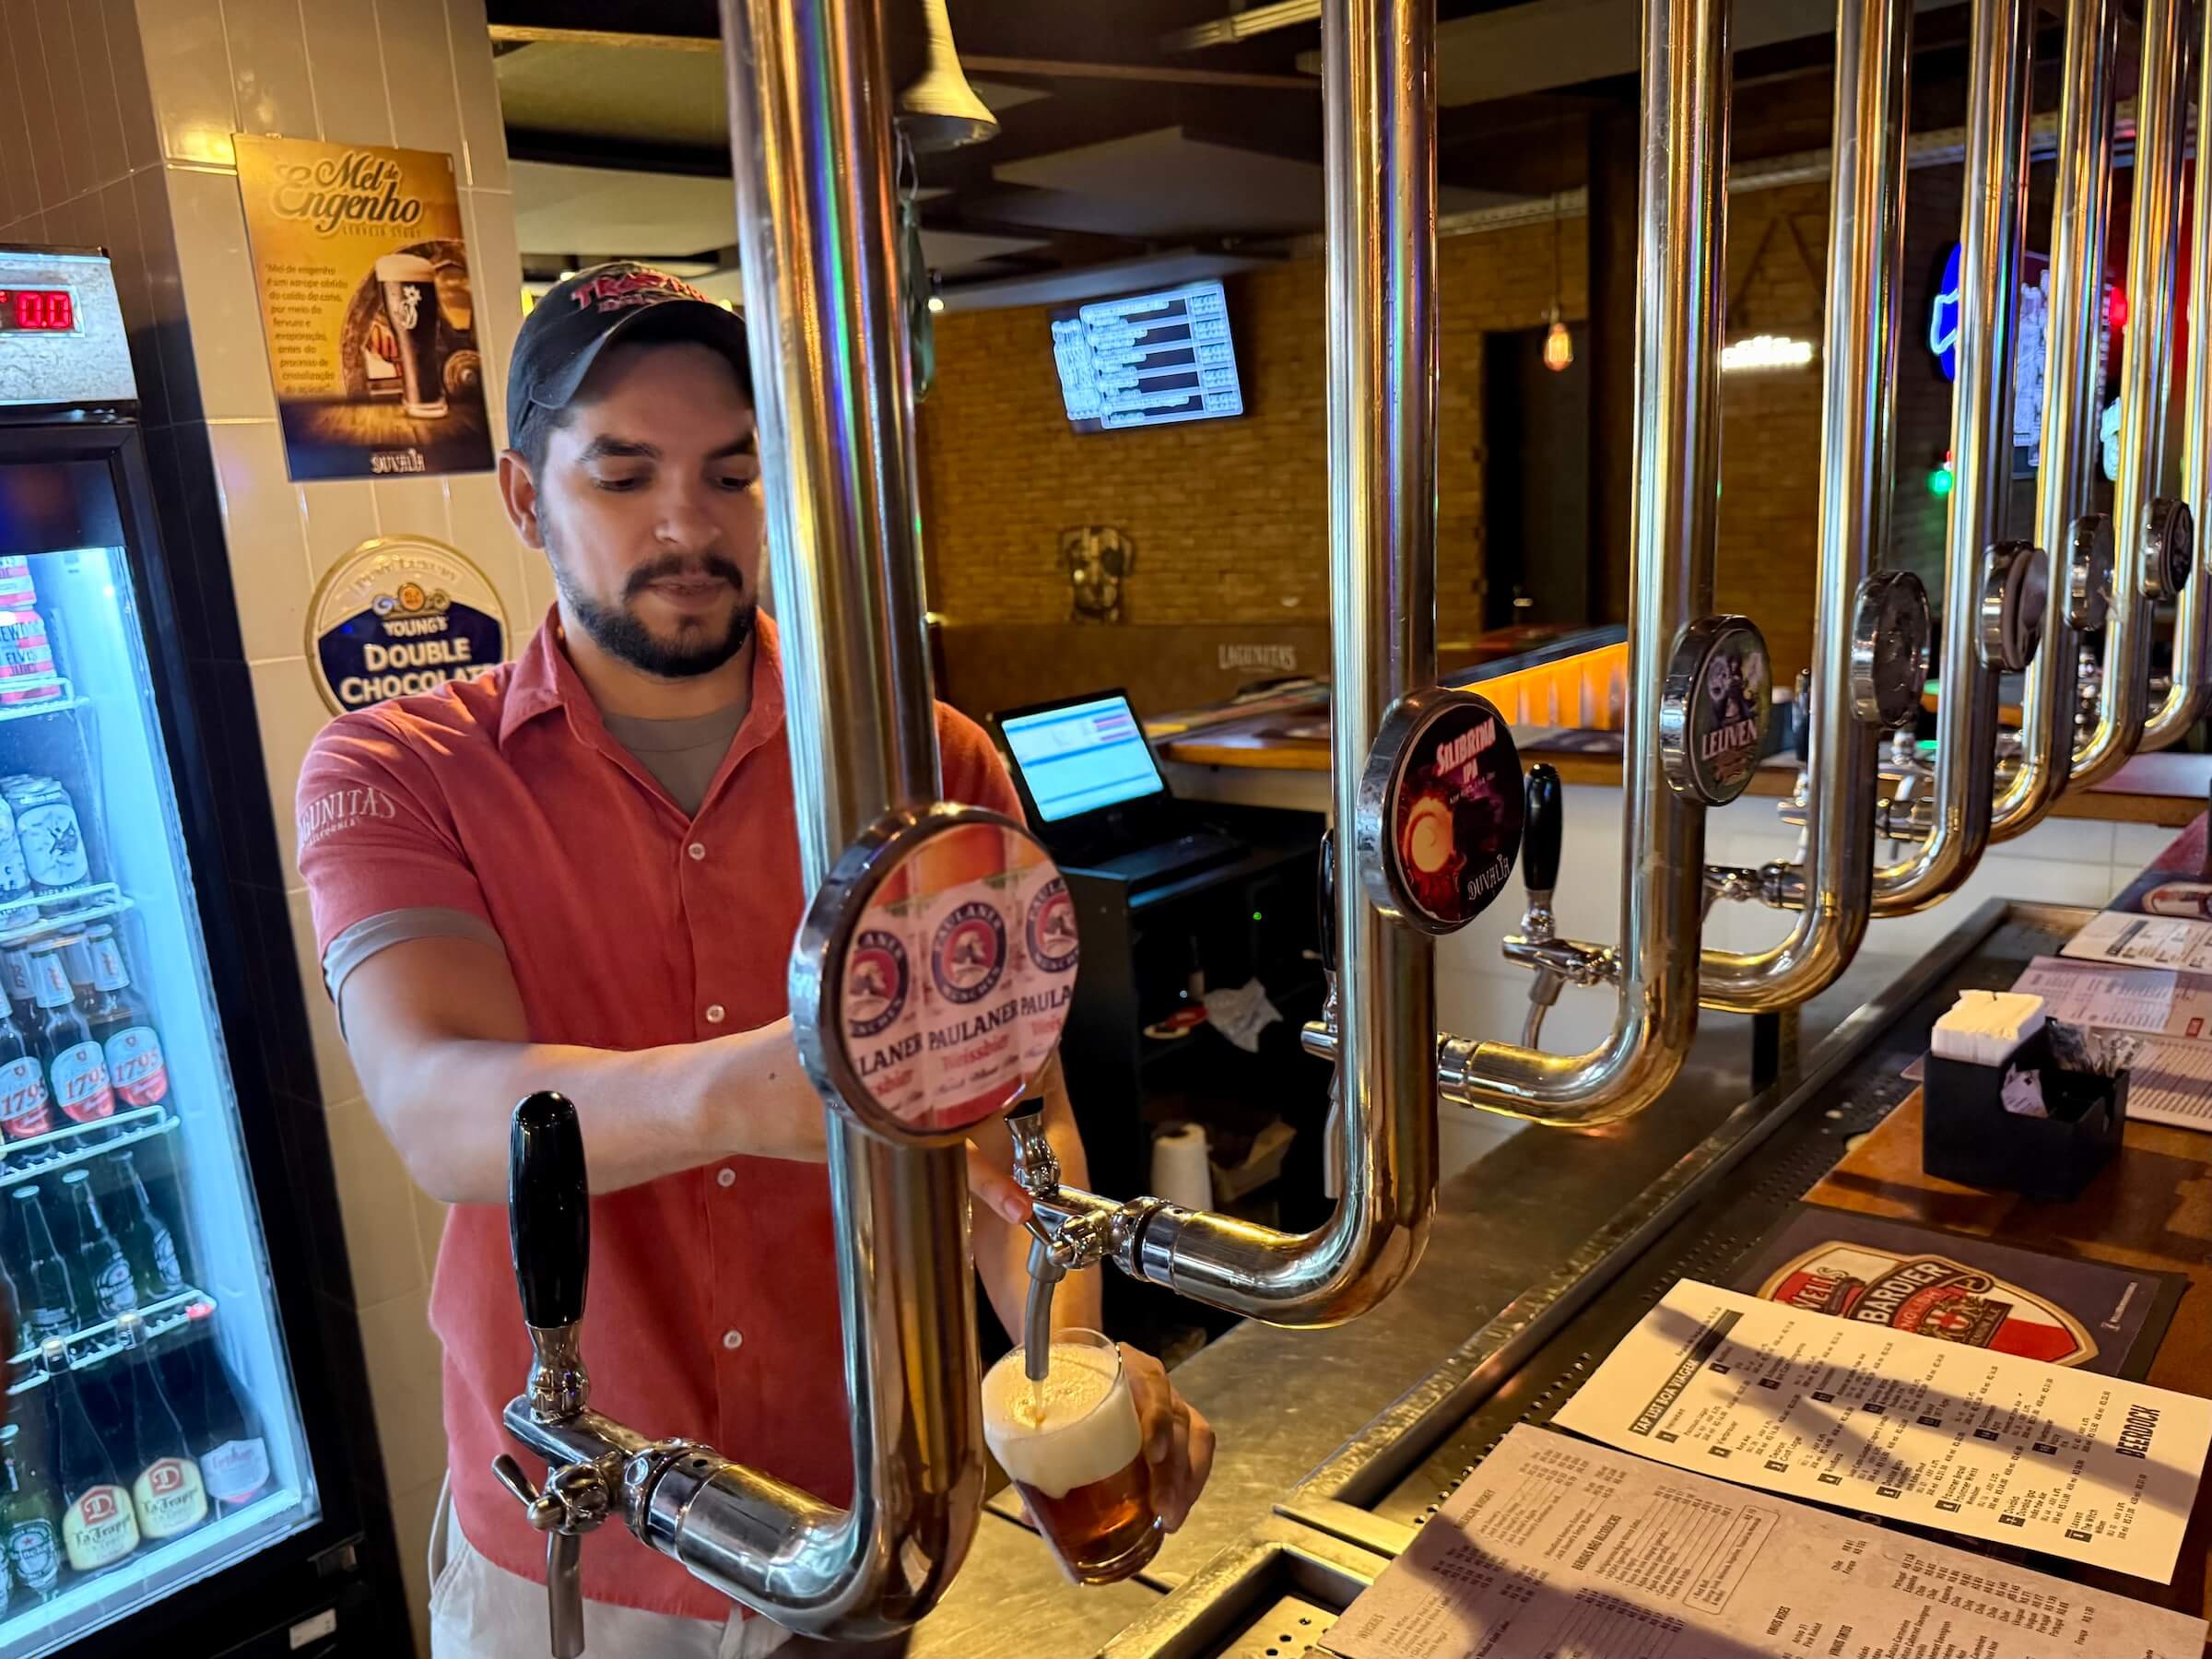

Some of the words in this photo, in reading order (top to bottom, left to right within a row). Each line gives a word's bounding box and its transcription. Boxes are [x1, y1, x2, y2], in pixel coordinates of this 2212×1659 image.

[315, 150, 383, 191] Mel
[277, 164, 420, 233] Engenho
[363, 637, 472, 672] DOUBLE
[1020, 984, 1072, 1016] PAULA
[928, 1000, 1018, 1051] PAULANER
[859, 1033, 924, 1077] LANER
[1857, 1262, 1954, 1328] BARDIER
[1668, 1359, 1700, 1387] VIAGEM
[1641, 1403, 1665, 1419] LIST
[1654, 1386, 1677, 1404] BOA
[1632, 1418, 1653, 1432] TAP
[2114, 1403, 2160, 1459] BEERDOCK
